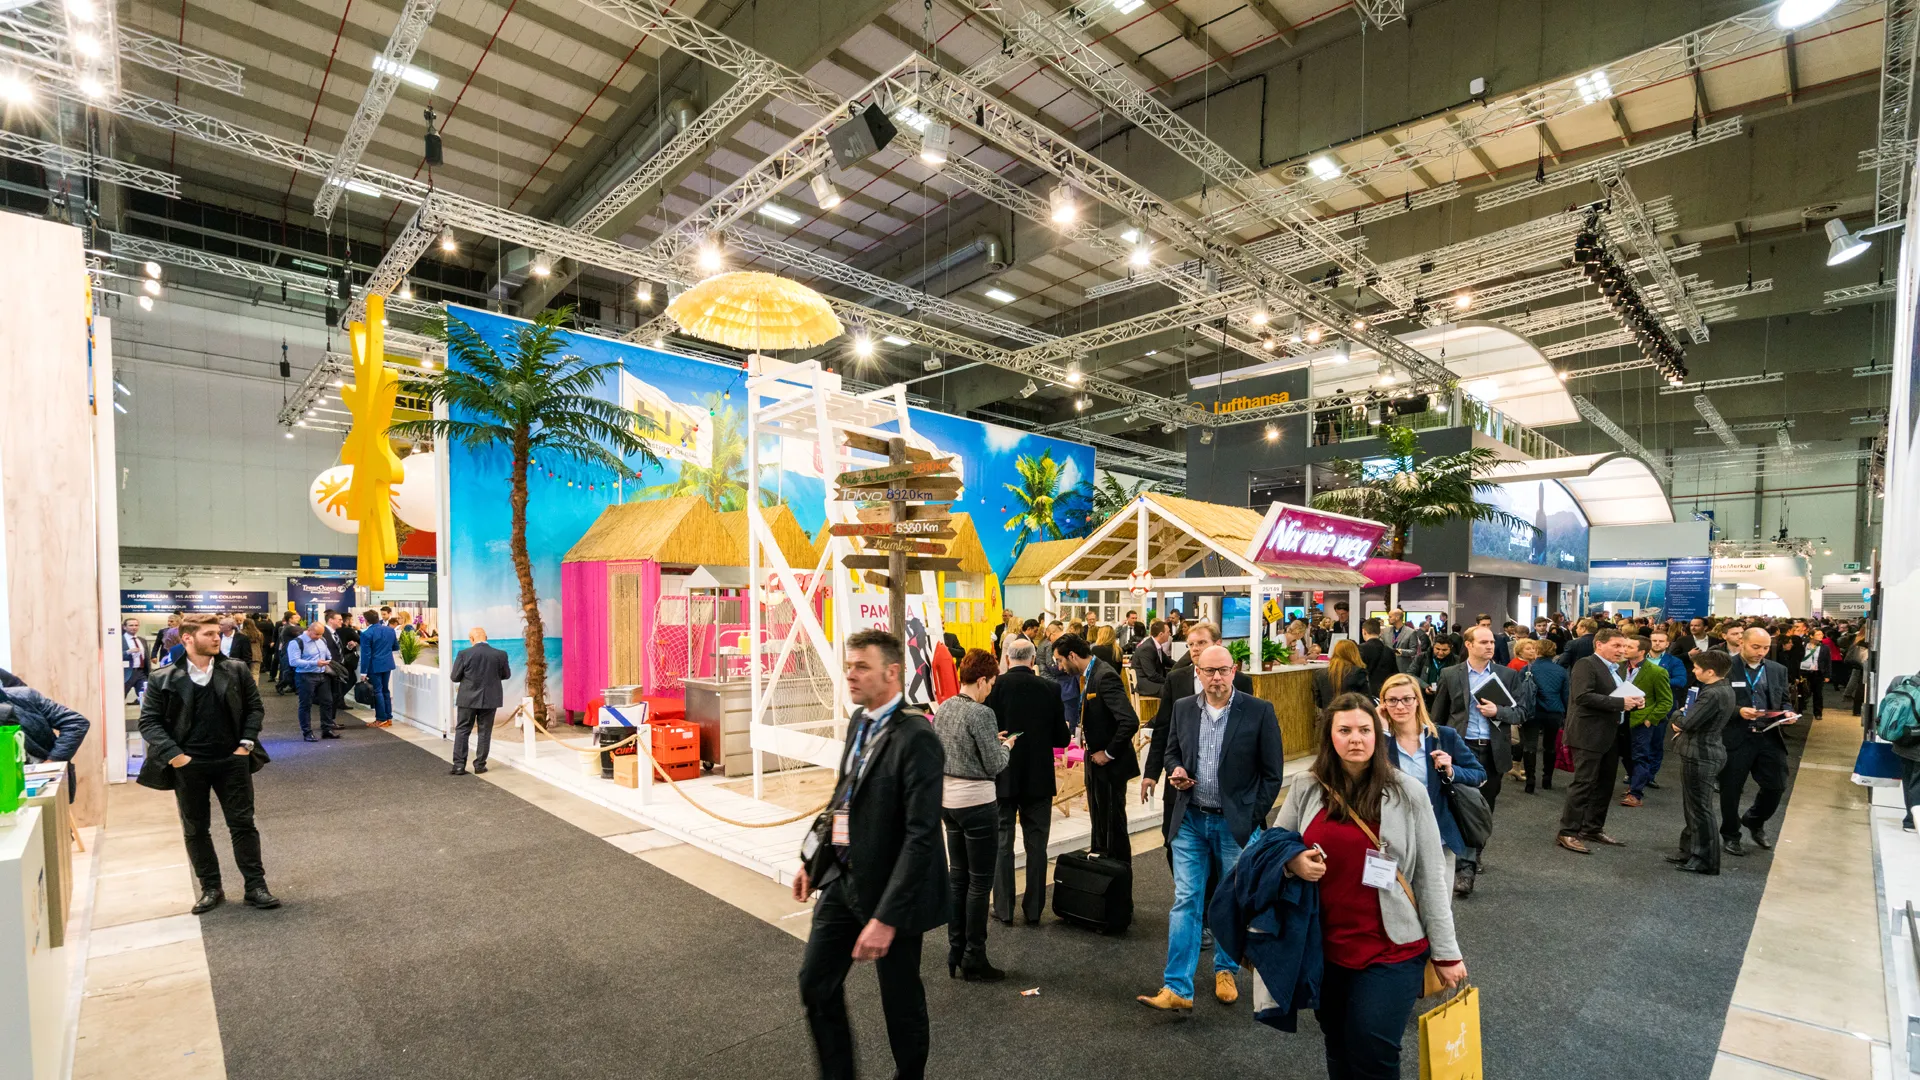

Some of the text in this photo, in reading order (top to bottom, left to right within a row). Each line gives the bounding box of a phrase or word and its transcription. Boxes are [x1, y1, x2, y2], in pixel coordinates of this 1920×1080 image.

[1213, 391, 1290, 415] Lufthansa
[841, 473, 859, 484] Rio
[840, 488, 883, 501] Tokyo
[895, 523, 922, 534] 6380
[1266, 519, 1307, 552] Nix
[1300, 526, 1337, 556] wie
[873, 539, 914, 552] Mumbai
[860, 604, 915, 618] PAMA
